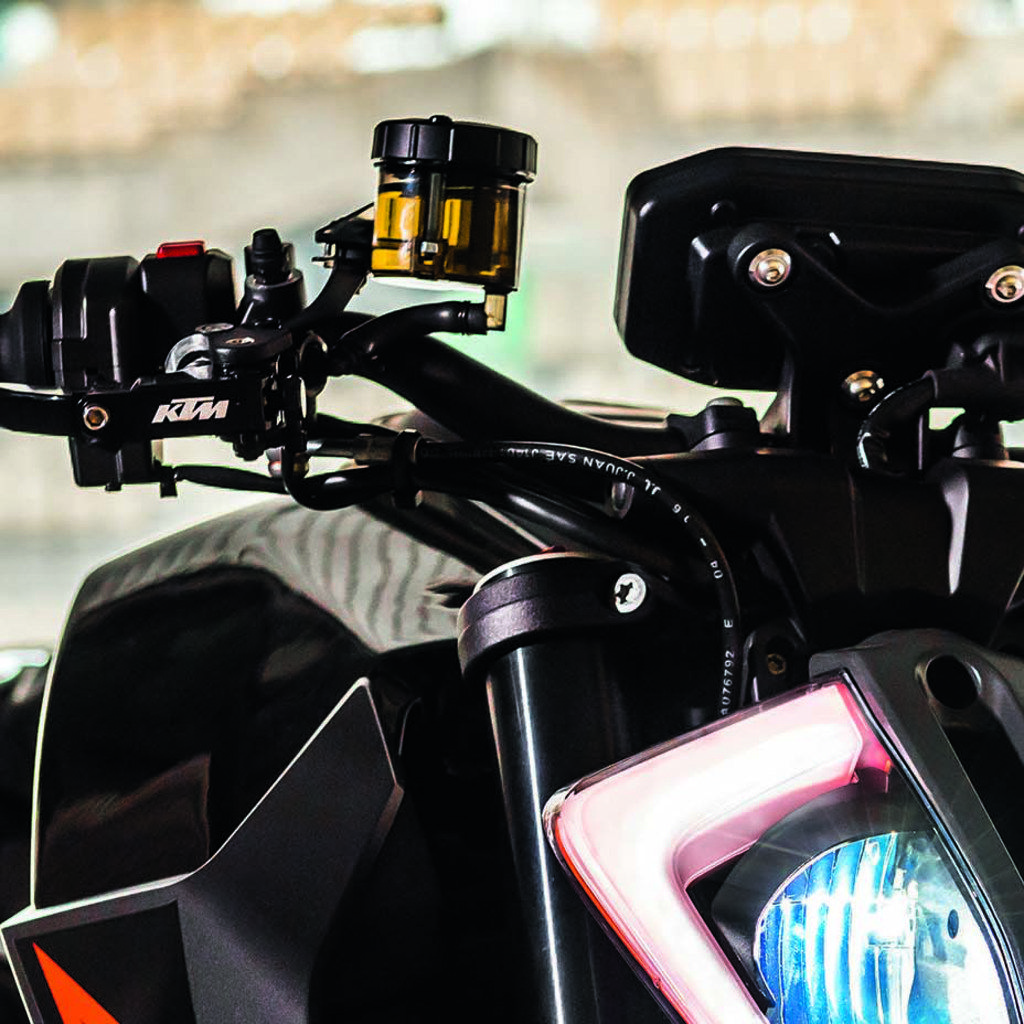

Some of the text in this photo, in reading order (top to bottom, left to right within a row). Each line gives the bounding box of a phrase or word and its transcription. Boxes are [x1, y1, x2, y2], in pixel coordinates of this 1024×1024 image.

[151, 396, 229, 424] KTM
[546, 449, 577, 463] SAE
[584, 456, 636, 480] J.JUAN
